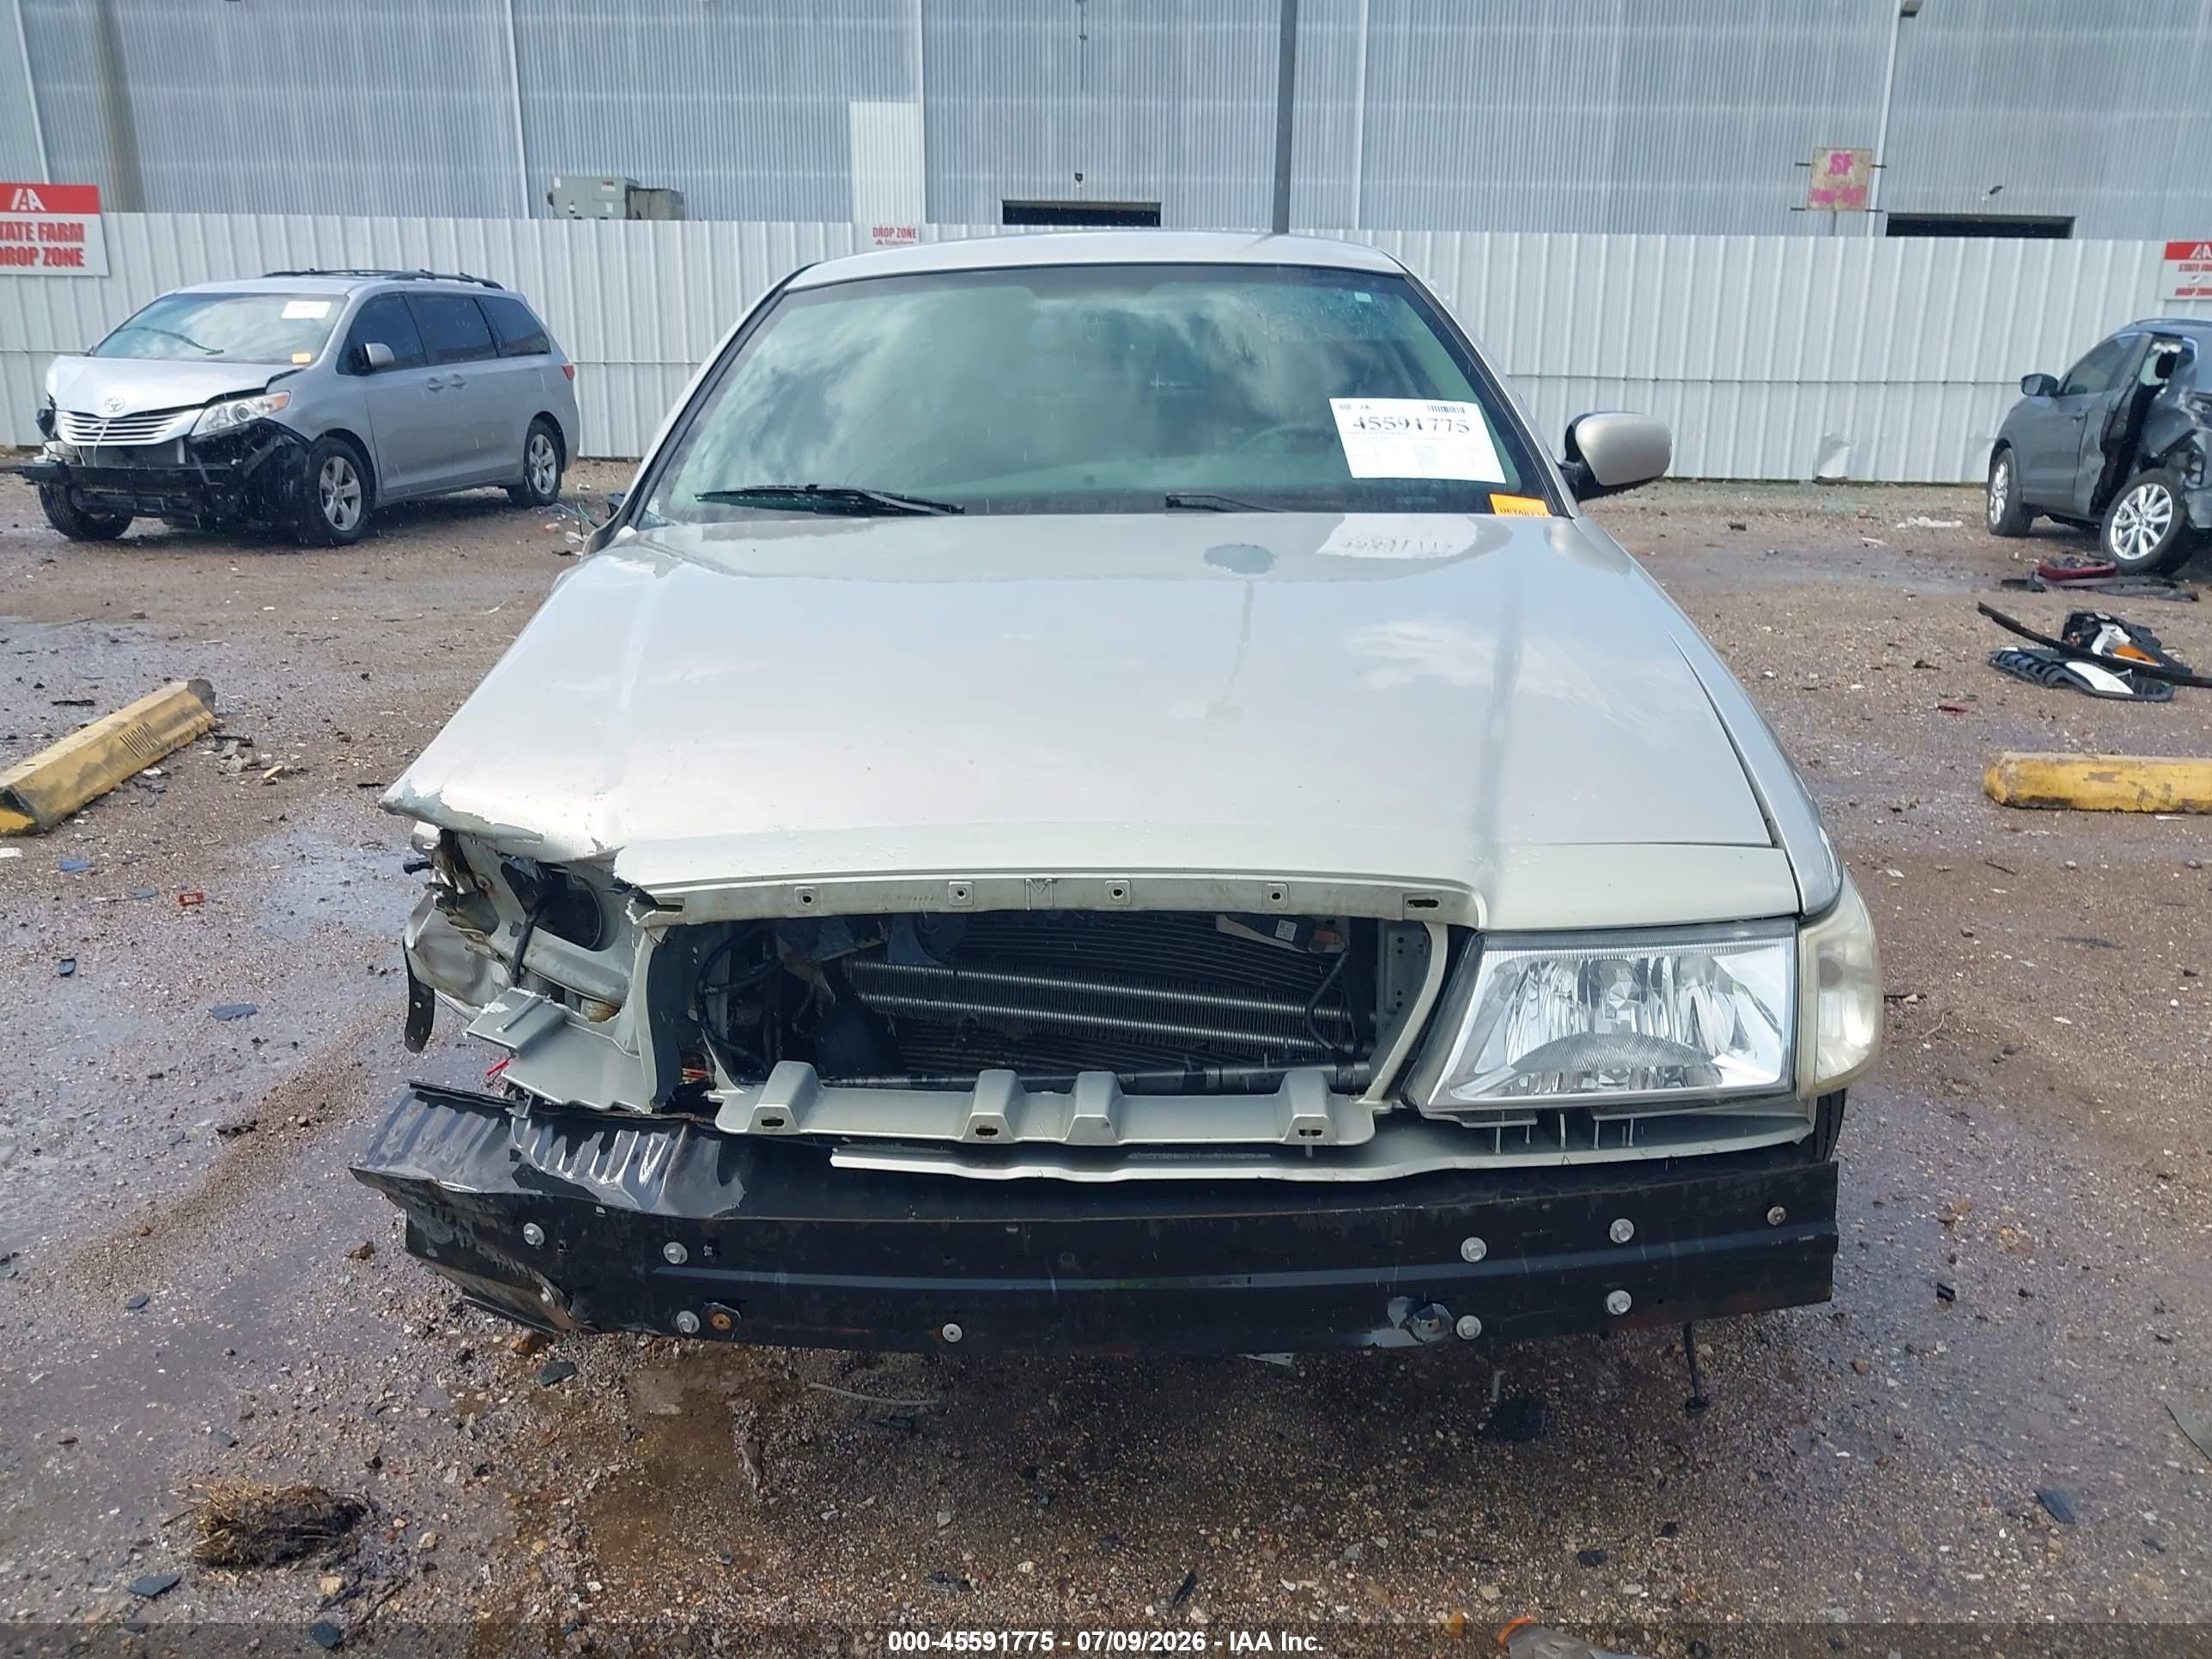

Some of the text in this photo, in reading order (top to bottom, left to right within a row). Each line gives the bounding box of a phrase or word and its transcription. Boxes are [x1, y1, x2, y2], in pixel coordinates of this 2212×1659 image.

[1829, 152, 1853, 175] SF
[38, 222, 84, 243] FARM
[872, 226, 916, 239] DROP ZONE
[42, 246, 85, 268] ZONE
[1352, 416, 1470, 434] 45591775
